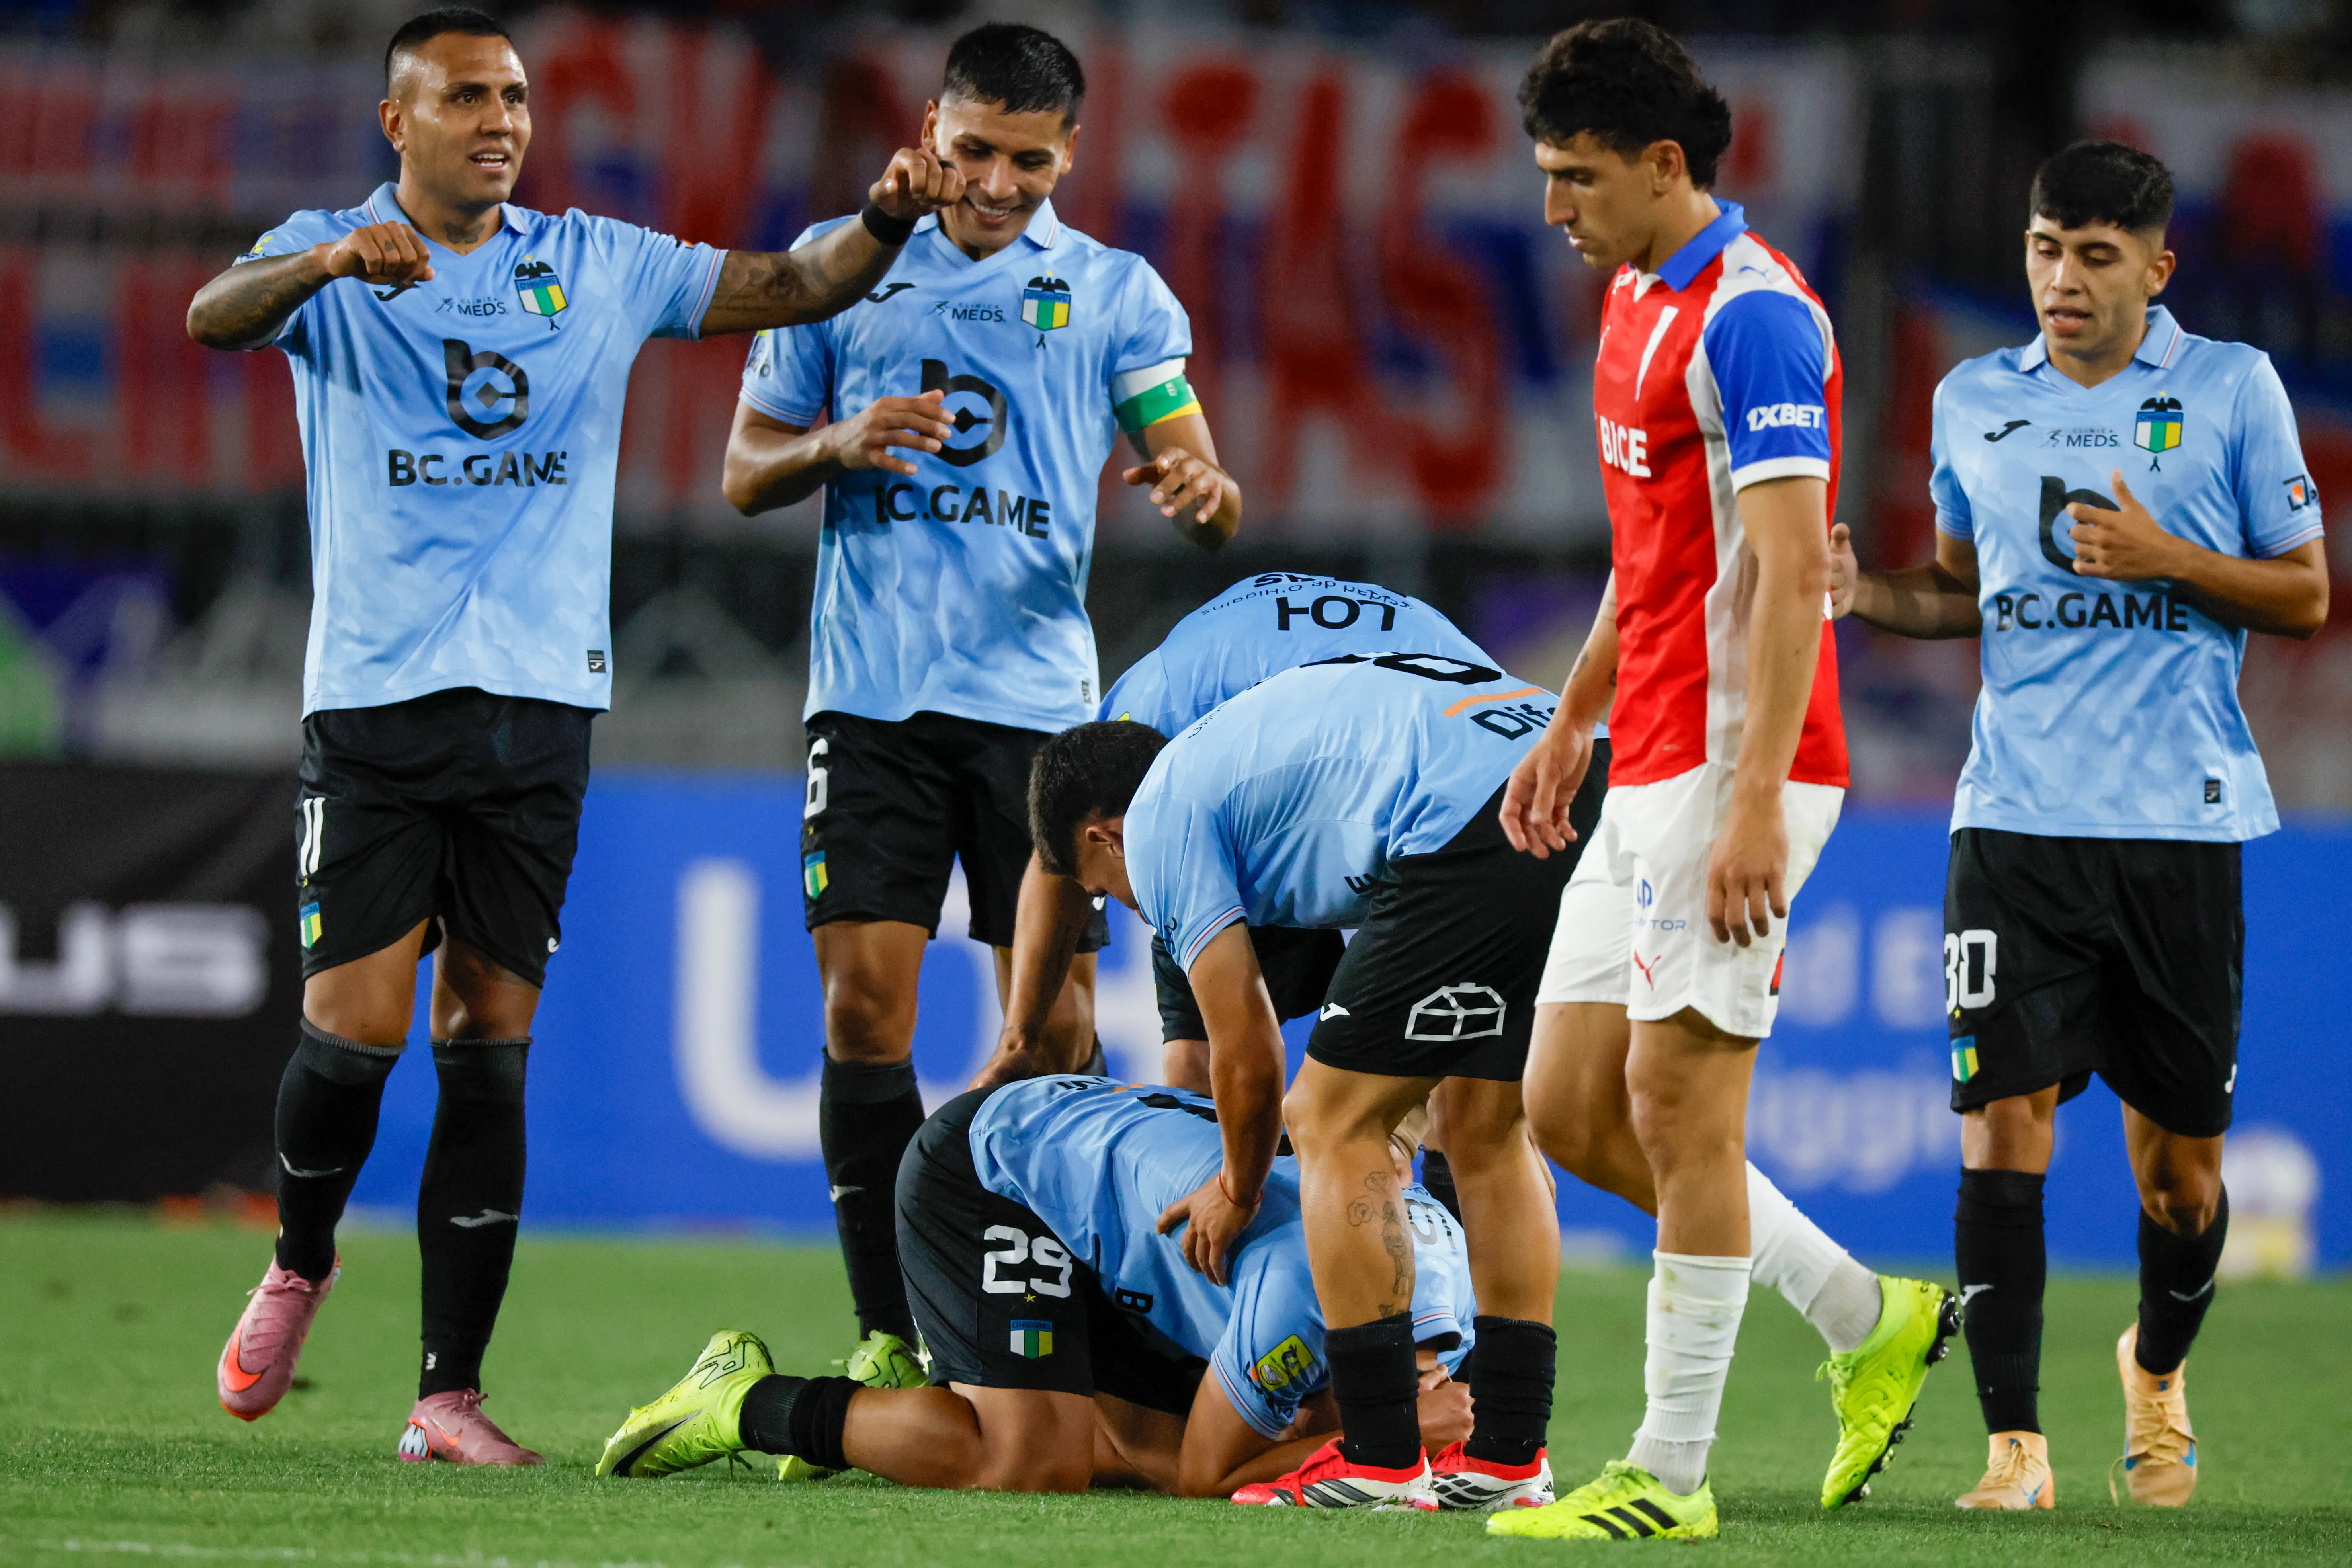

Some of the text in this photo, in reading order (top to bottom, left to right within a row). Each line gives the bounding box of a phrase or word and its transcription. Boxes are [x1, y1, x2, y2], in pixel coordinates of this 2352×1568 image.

[457, 301, 507, 316] MEDS
[952, 308, 1004, 322] MEDS
[1746, 403, 1825, 432] 1XBET
[1599, 415, 1652, 478] BICE
[2066, 434, 2118, 447] MEDS
[388, 449, 568, 487] BC.GAME
[1201, 585, 1303, 615] O'Higgins
[1996, 593, 2188, 632] BC.GAME
[1470, 703, 1557, 741] Dif
[1944, 929, 1997, 1015] 30
[982, 1224, 1073, 1299] 29
